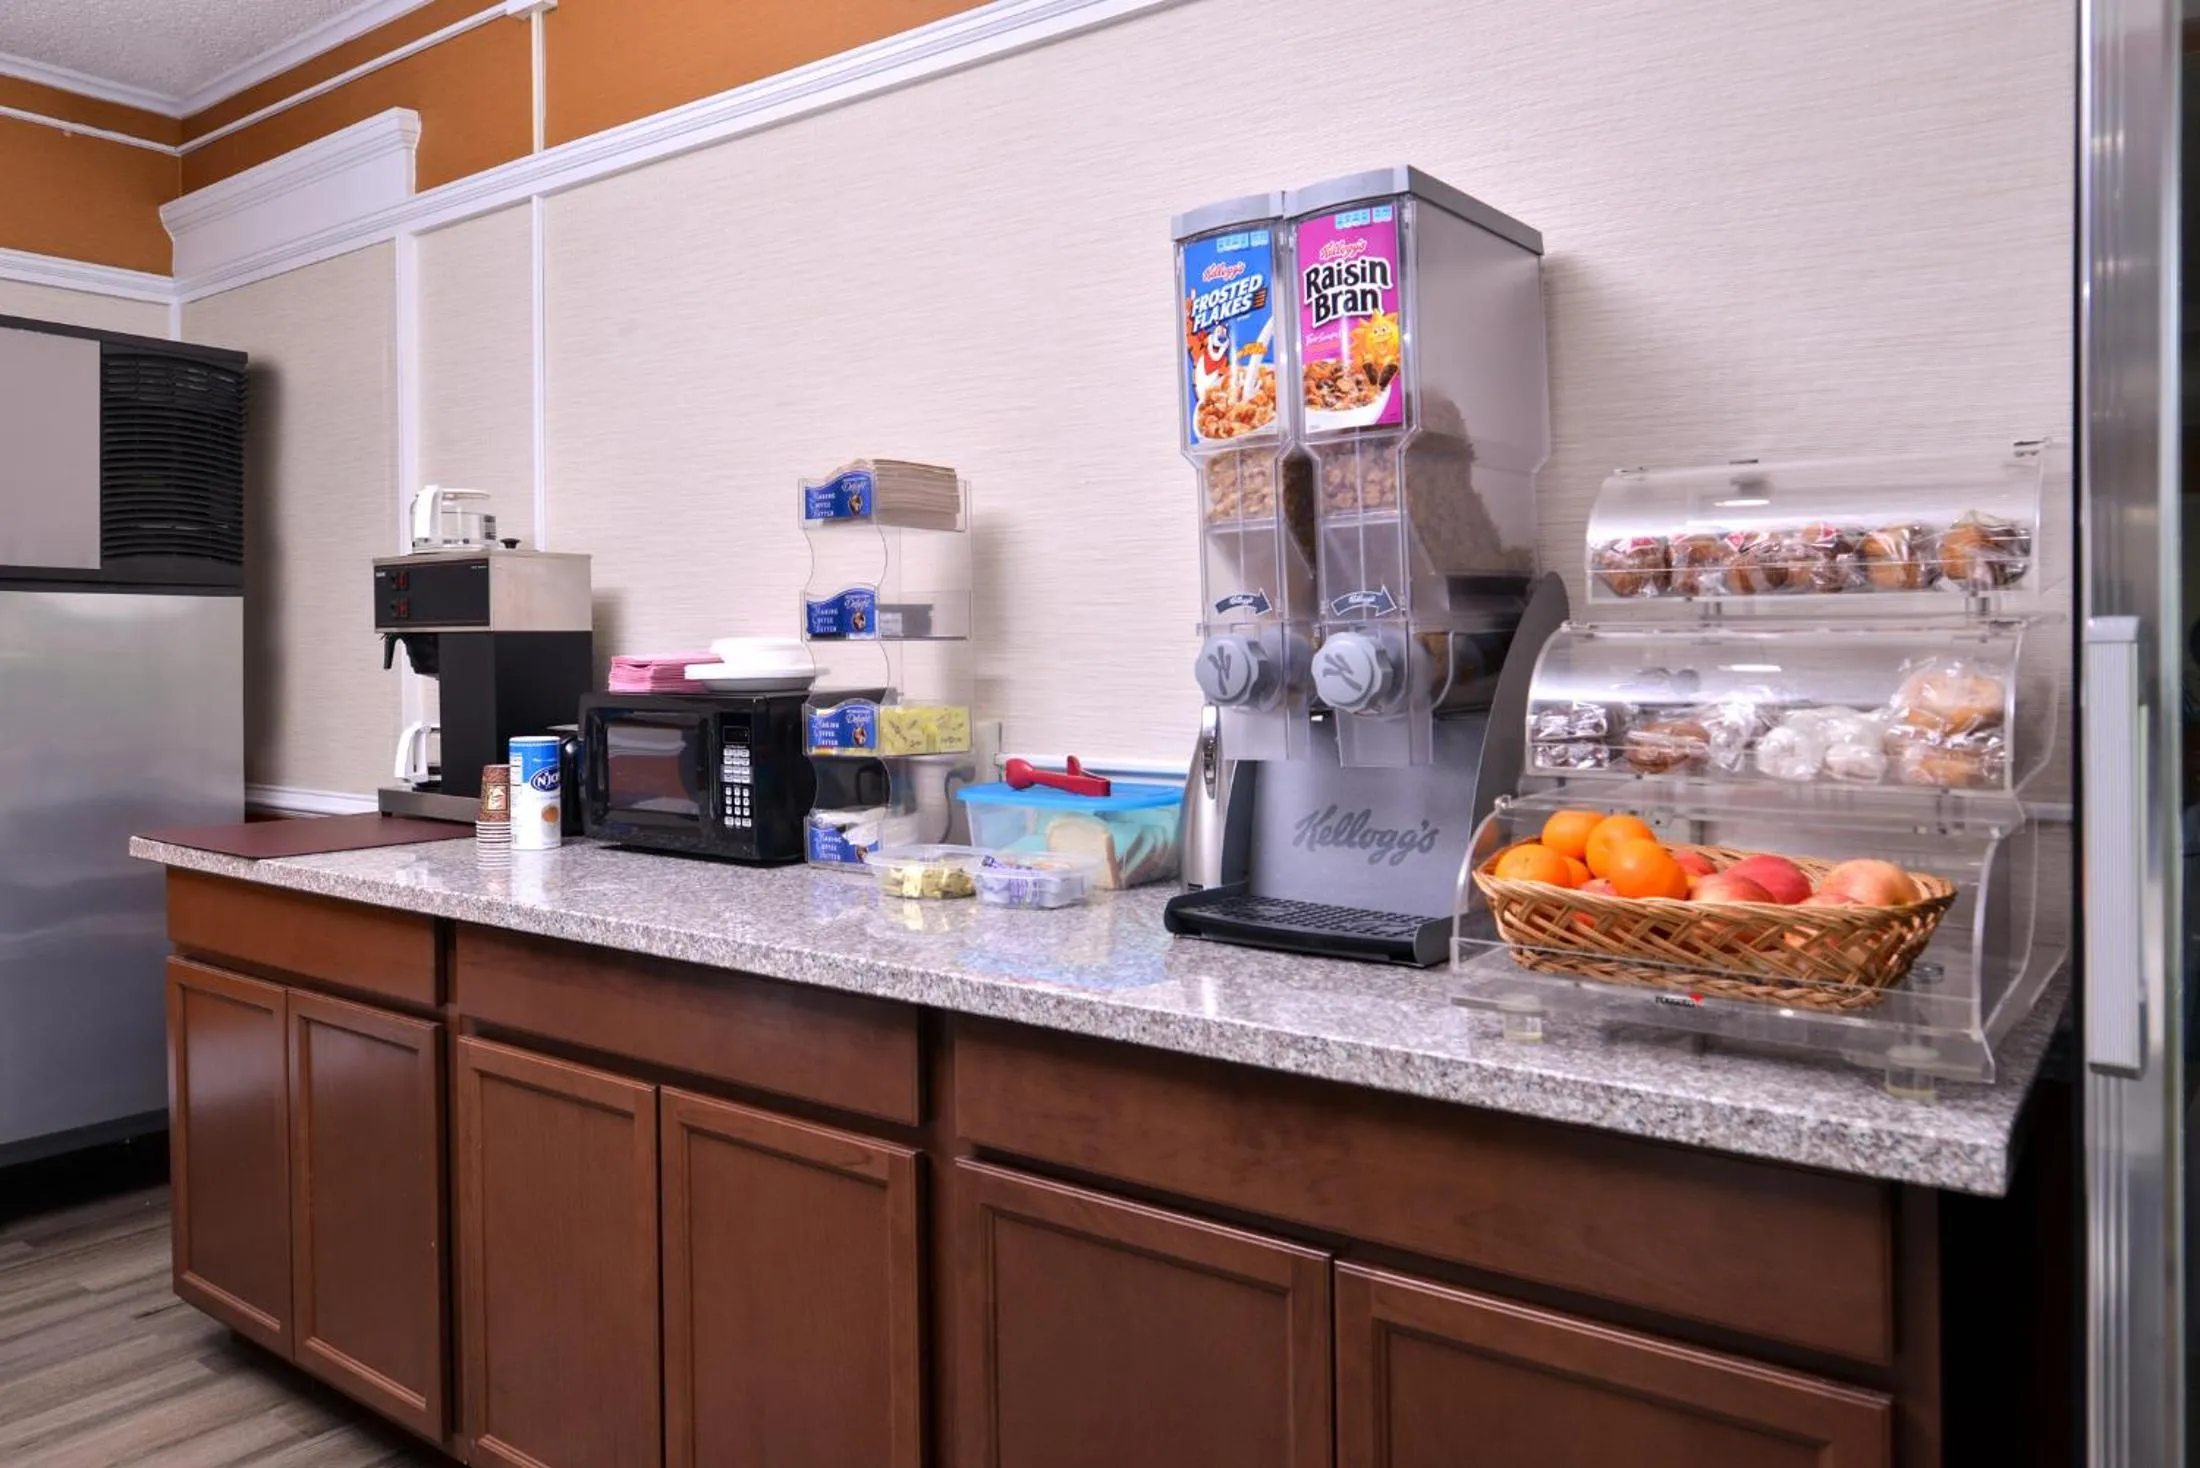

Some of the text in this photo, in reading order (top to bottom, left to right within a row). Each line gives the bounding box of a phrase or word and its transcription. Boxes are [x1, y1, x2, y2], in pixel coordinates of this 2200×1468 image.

[1192, 273, 1263, 317] FROSTED
[1304, 258, 1391, 303] Raisin
[1193, 294, 1253, 333] FLAKES
[1313, 287, 1381, 324] Bran
[1293, 805, 1440, 866] Kellogg's
